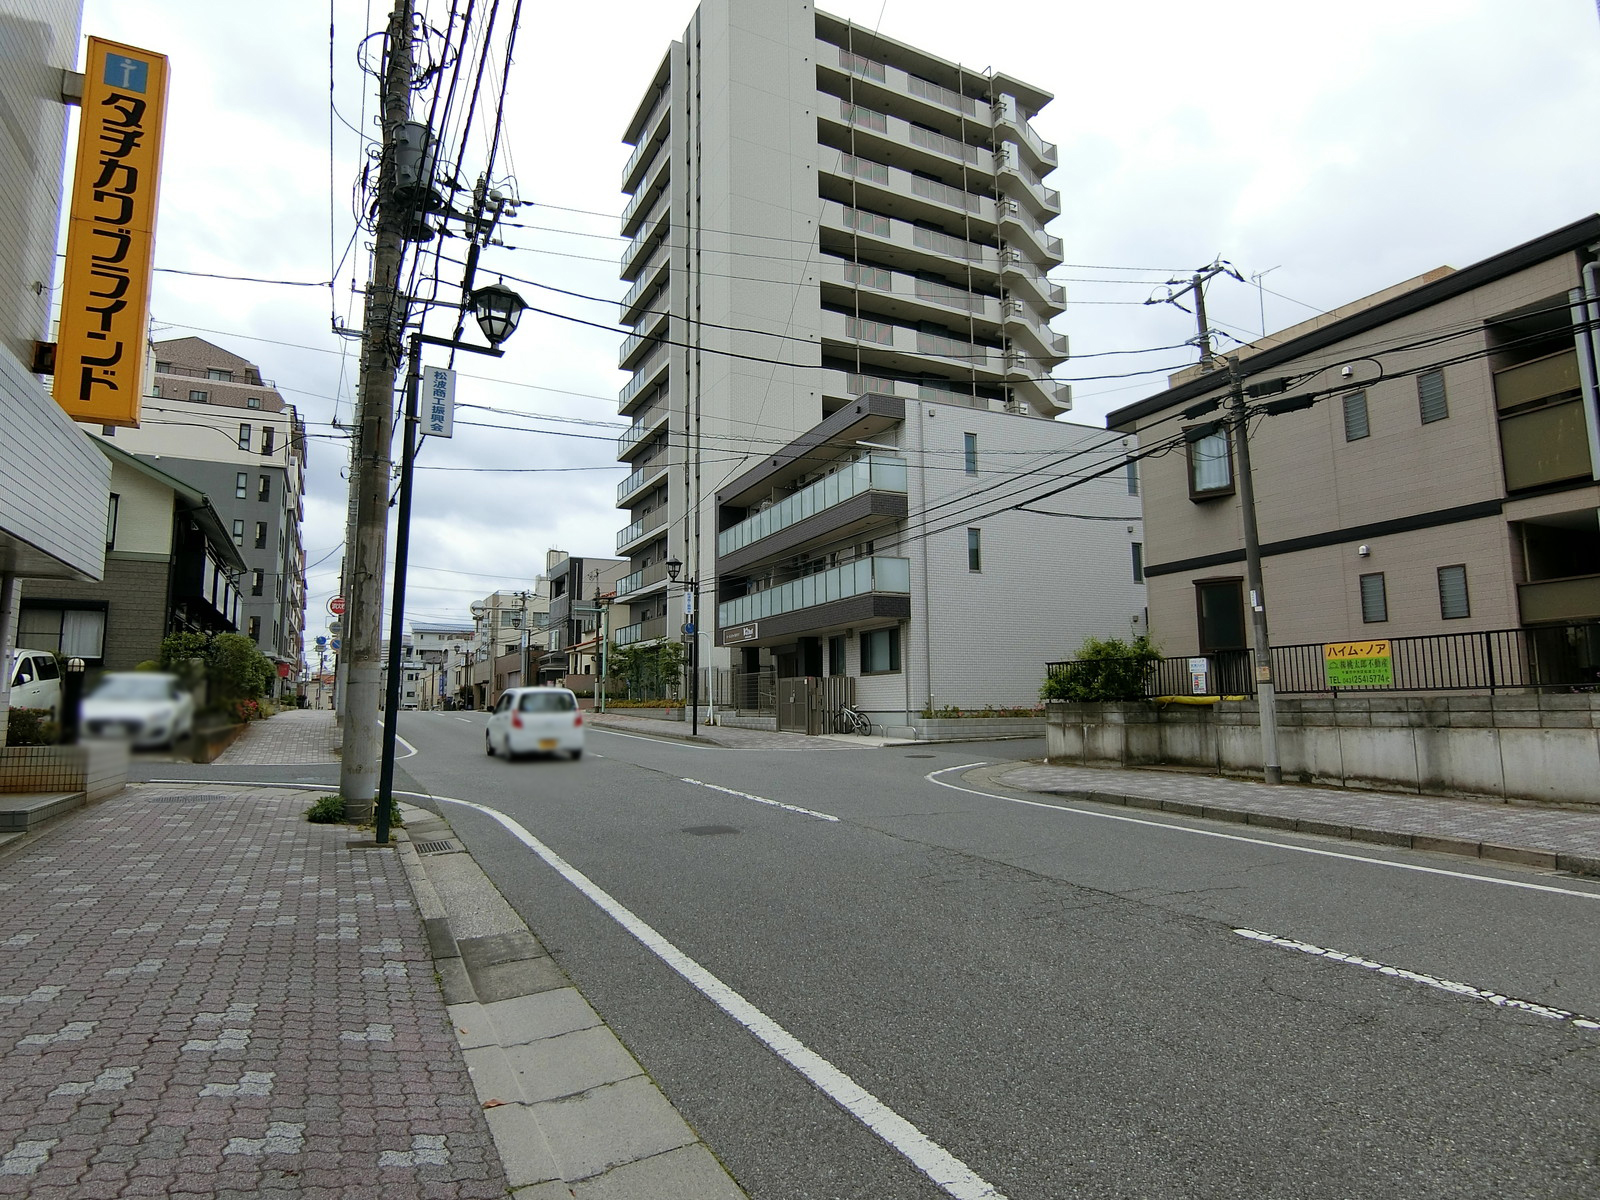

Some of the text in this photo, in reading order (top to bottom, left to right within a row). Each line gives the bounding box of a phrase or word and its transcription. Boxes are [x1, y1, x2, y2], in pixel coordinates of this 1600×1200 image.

[79, 92, 146, 401] タチカワブラインド
[430, 371, 447, 432] 松波商工振興会
[1327, 643, 1386, 656] ハイム・ノア
[1329, 675, 1341, 684] TEL
